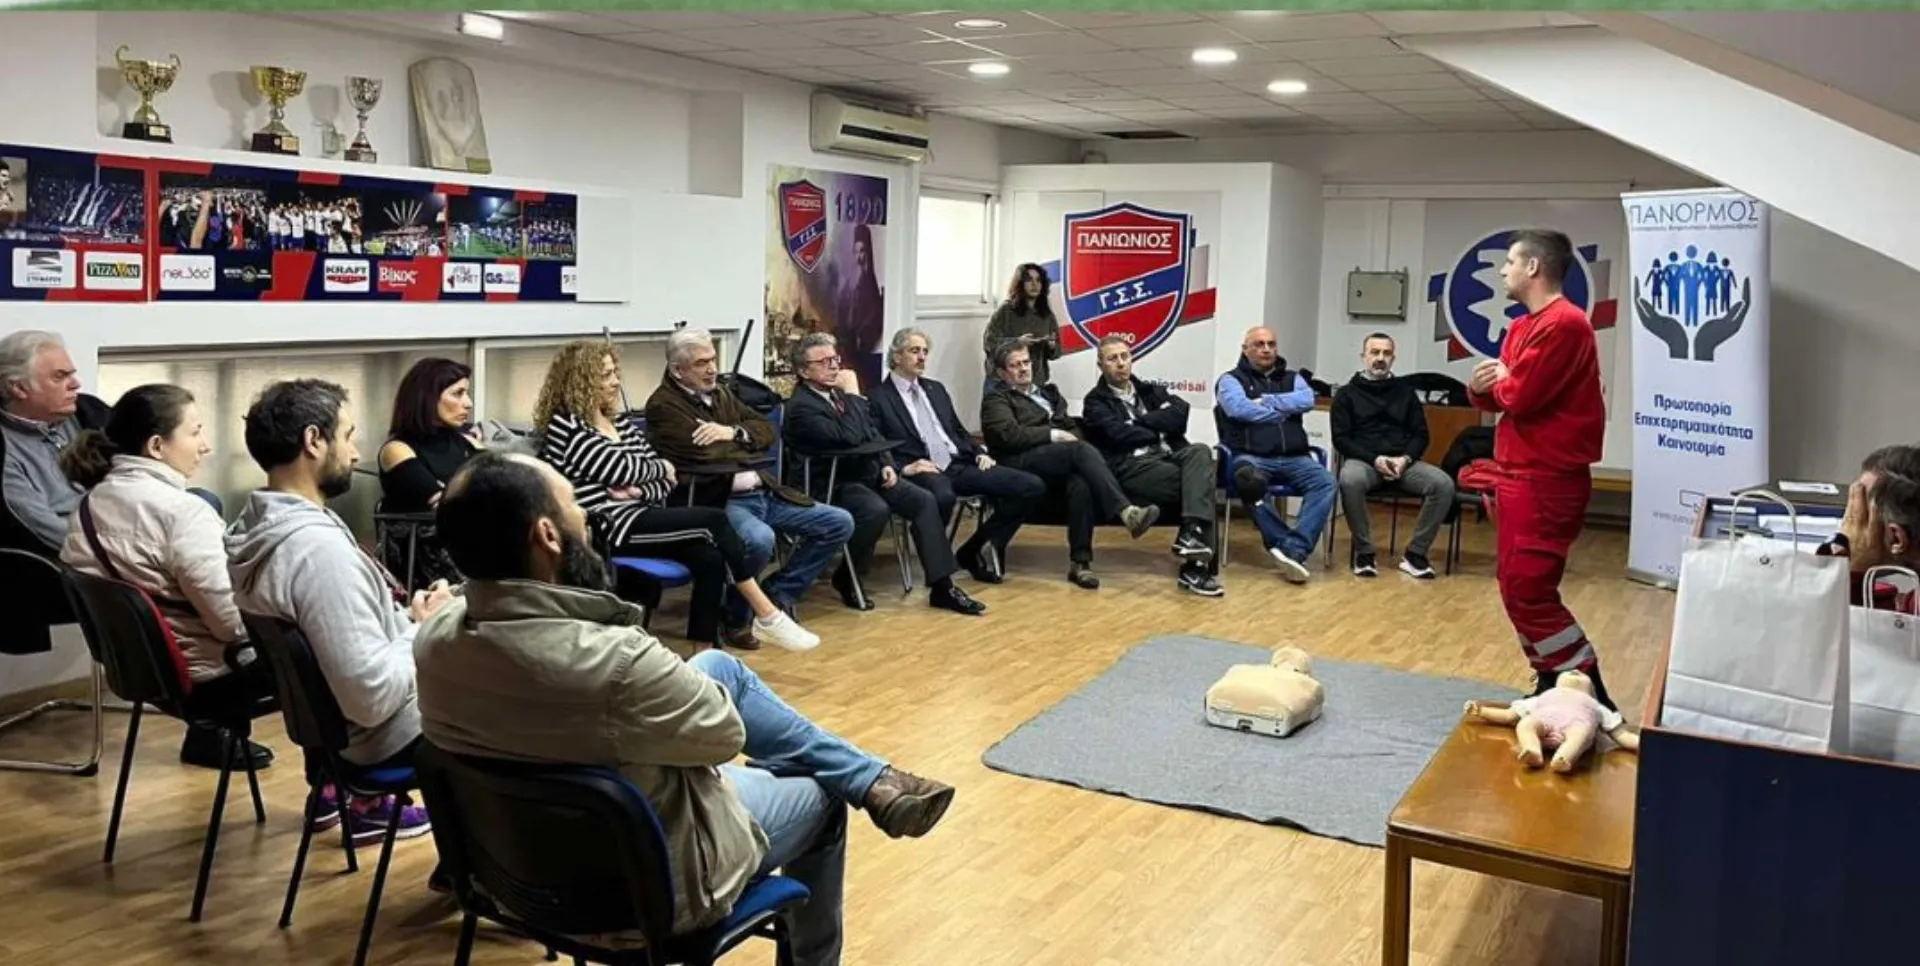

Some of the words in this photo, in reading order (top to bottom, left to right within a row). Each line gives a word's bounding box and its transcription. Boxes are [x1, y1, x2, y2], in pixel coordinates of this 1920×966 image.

[835, 192, 884, 224] 1890
[1629, 200, 1759, 225] ΠΑΝΟΡΜΟΣ
[1077, 232, 1173, 248] ΠΑΝΙΩΝΙΟΣ
[326, 266, 367, 274] KRAFT
[1653, 394, 1732, 417] Πρωτοπορία
[1634, 412, 1754, 440] Επιχειρηματικότητα
[1657, 434, 1726, 457] Καινοτομία
